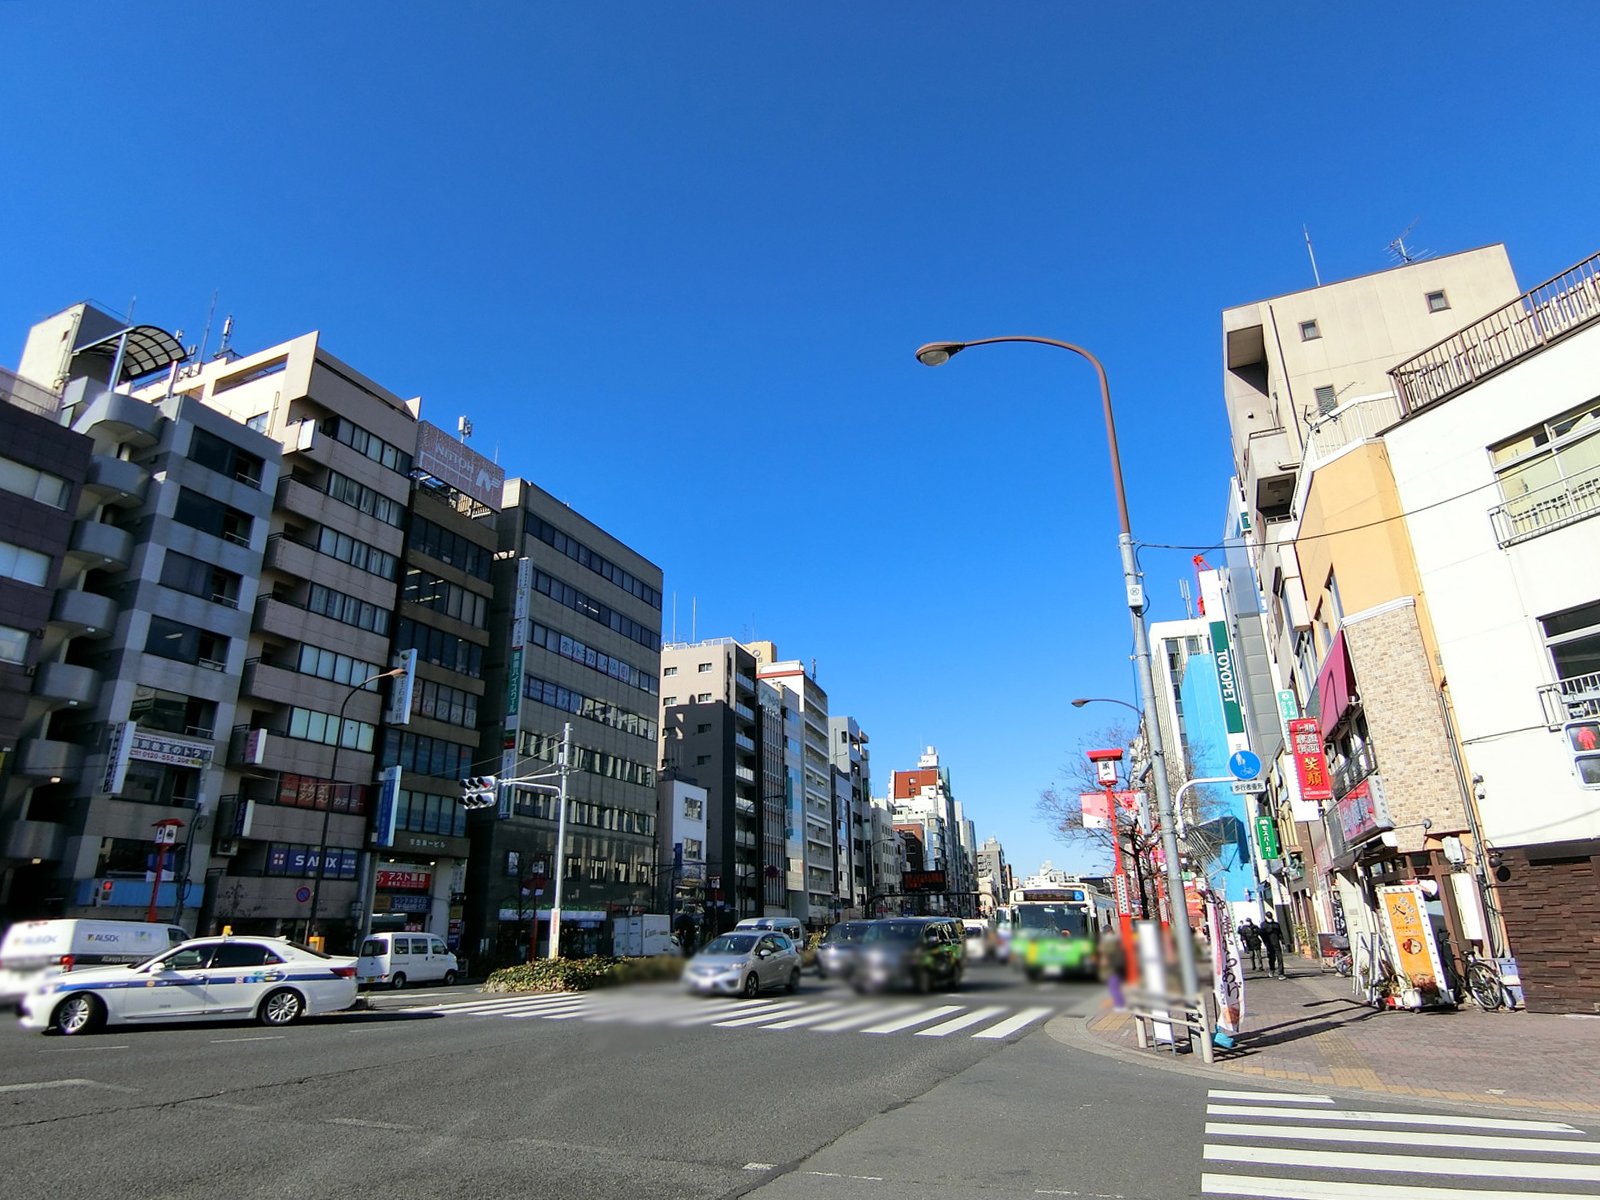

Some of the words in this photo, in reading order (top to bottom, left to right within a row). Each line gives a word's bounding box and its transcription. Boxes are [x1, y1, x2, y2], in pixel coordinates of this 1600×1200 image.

[1216, 649, 1237, 704] TOYOPET
[1234, 783, 1264, 791] 歩行者優先
[1262, 825, 1272, 857] モスバーガー
[95, 934, 119, 942] ALSOK
